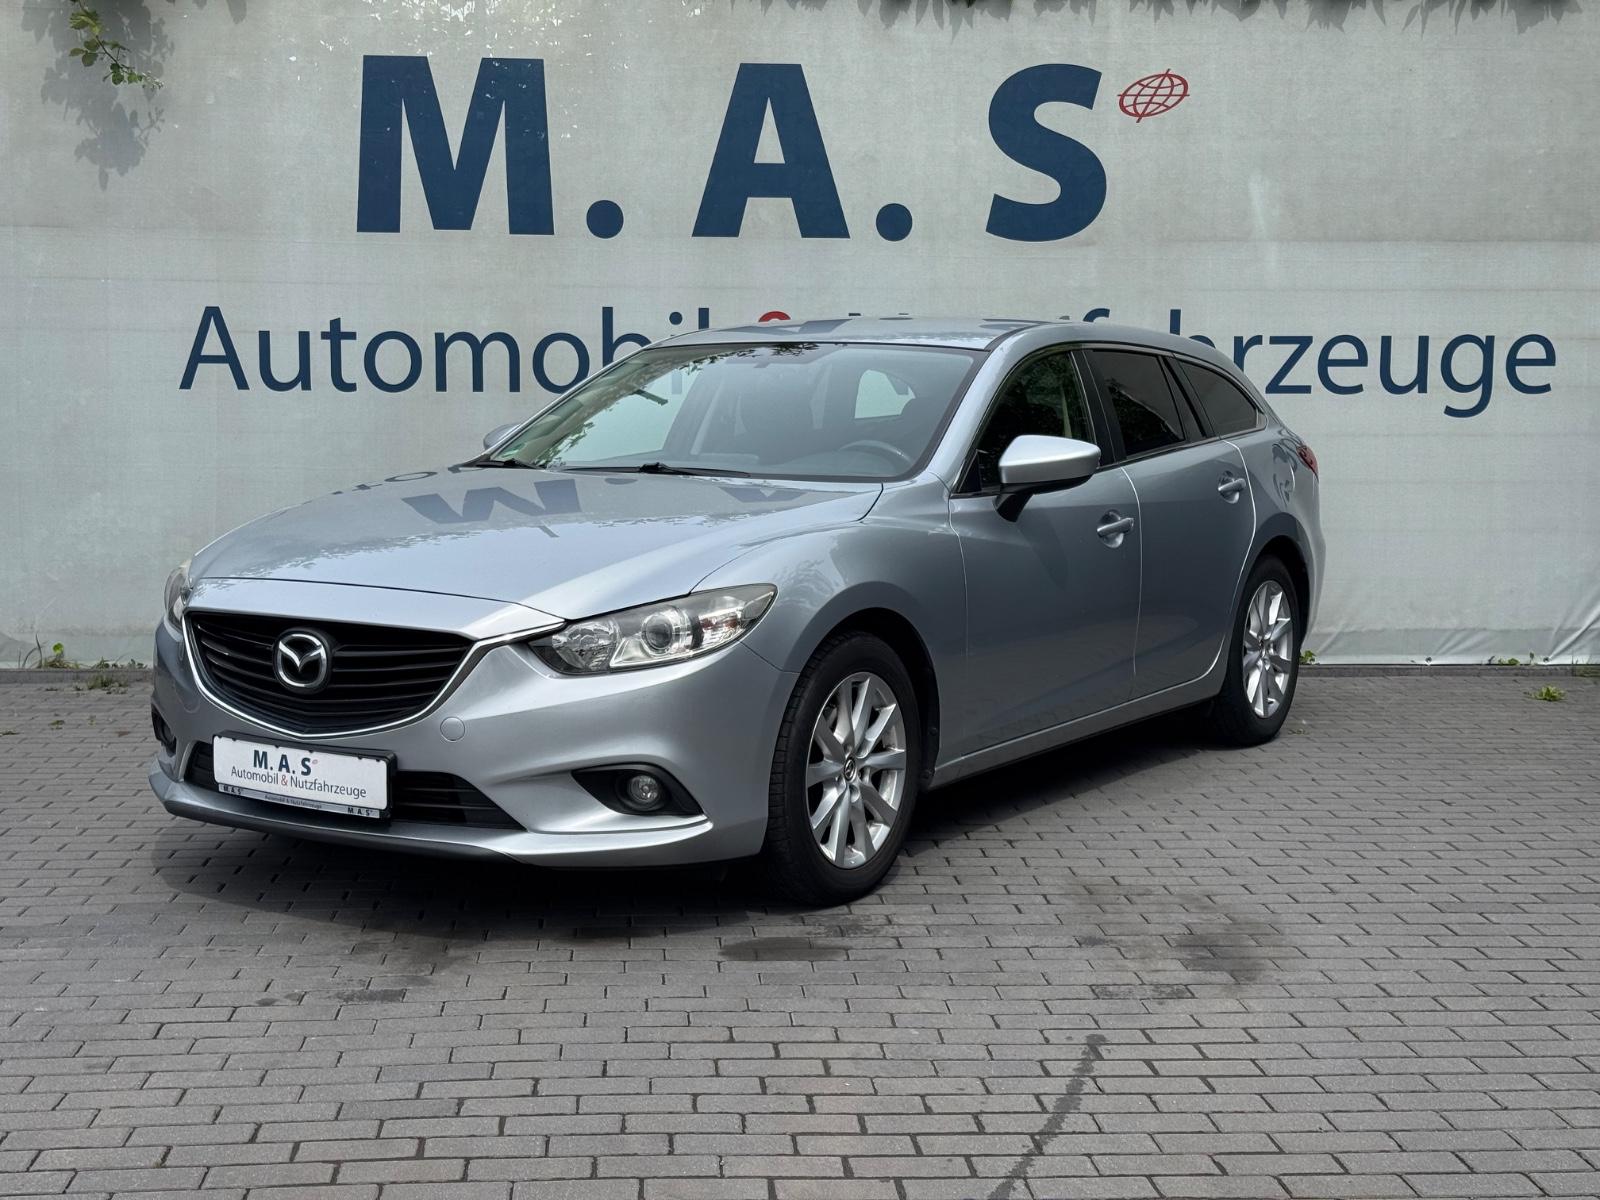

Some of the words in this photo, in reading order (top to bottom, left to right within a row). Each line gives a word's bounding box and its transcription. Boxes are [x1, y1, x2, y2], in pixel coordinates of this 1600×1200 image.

[179, 306, 709, 394] Automob
[231, 766, 279, 784] Automobil
[281, 774, 288, 786] &
[290, 775, 367, 799] Nutzfahrzeuge
